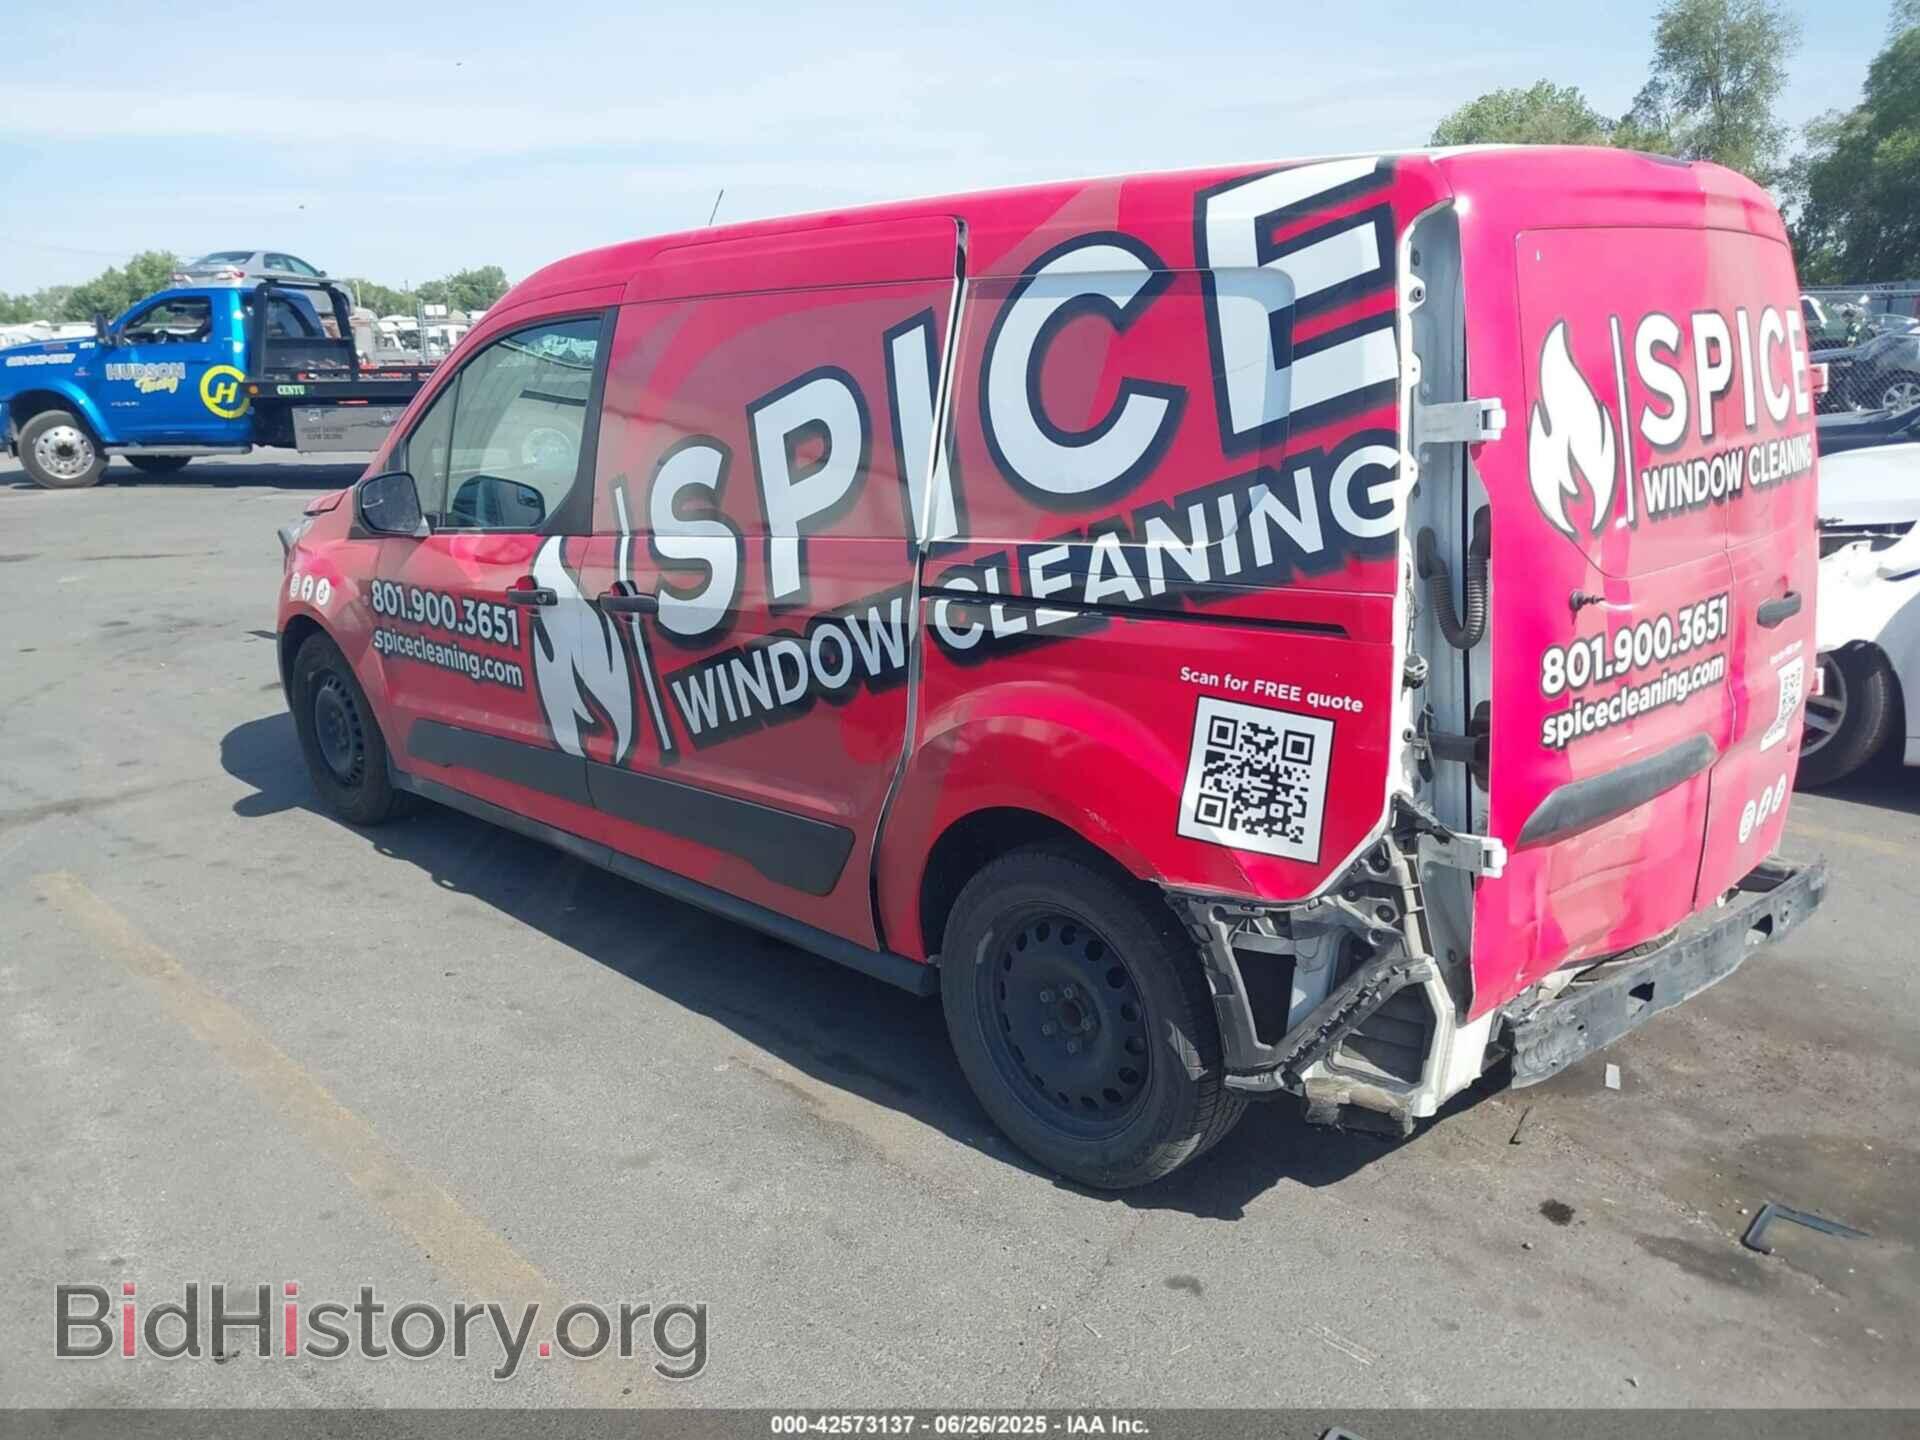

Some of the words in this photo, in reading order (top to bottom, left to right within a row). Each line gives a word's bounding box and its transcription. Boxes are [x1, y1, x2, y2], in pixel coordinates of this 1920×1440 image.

[105, 362, 186, 381] HUDSON
[648, 157, 1400, 636] SPICE
[1634, 308, 1811, 447] SPICE
[1642, 450, 1746, 513] WINDOW
[1747, 437, 1812, 484] CLEANING
[371, 580, 520, 645] 801.900.3651
[670, 597, 909, 738] WINDOW
[933, 443, 1403, 651] CLEANING
[373, 628, 524, 688] spicecleaning.com
[1541, 595, 1728, 694] 801.900.3651
[1180, 666, 1219, 687] Scan
[1223, 674, 1249, 692] for
[1253, 679, 1302, 702] FREE
[1306, 691, 1364, 713] quote
[1542, 655, 1725, 746] spicecleaning.com
